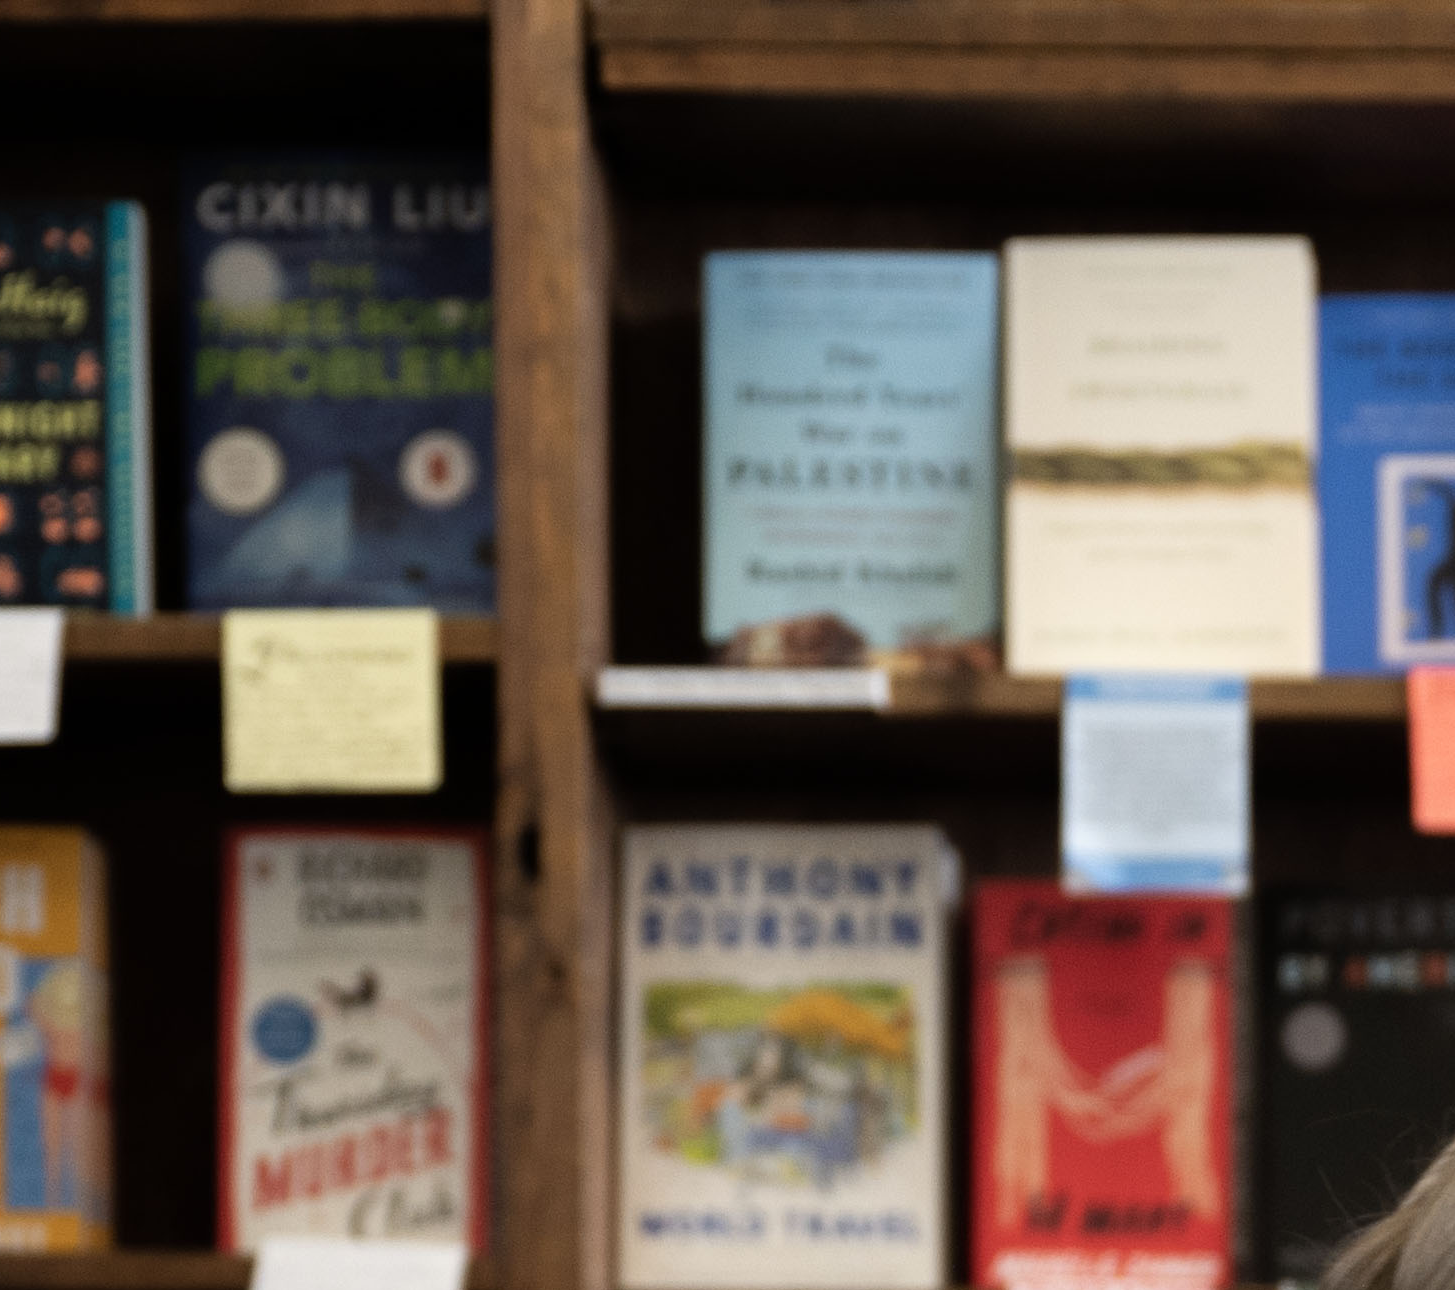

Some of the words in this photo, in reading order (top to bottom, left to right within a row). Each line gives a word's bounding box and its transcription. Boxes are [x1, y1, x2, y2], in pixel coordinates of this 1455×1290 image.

[196, 182, 368, 233] CIXIN
[393, 184, 492, 231] LIU
[196, 346, 494, 395] PROBLEM
[728, 459, 974, 492] PALESTINE
[645, 862, 920, 899] ANTHONY
[643, 909, 922, 946] BOURDAIN
[253, 1112, 454, 1208] MURDER
